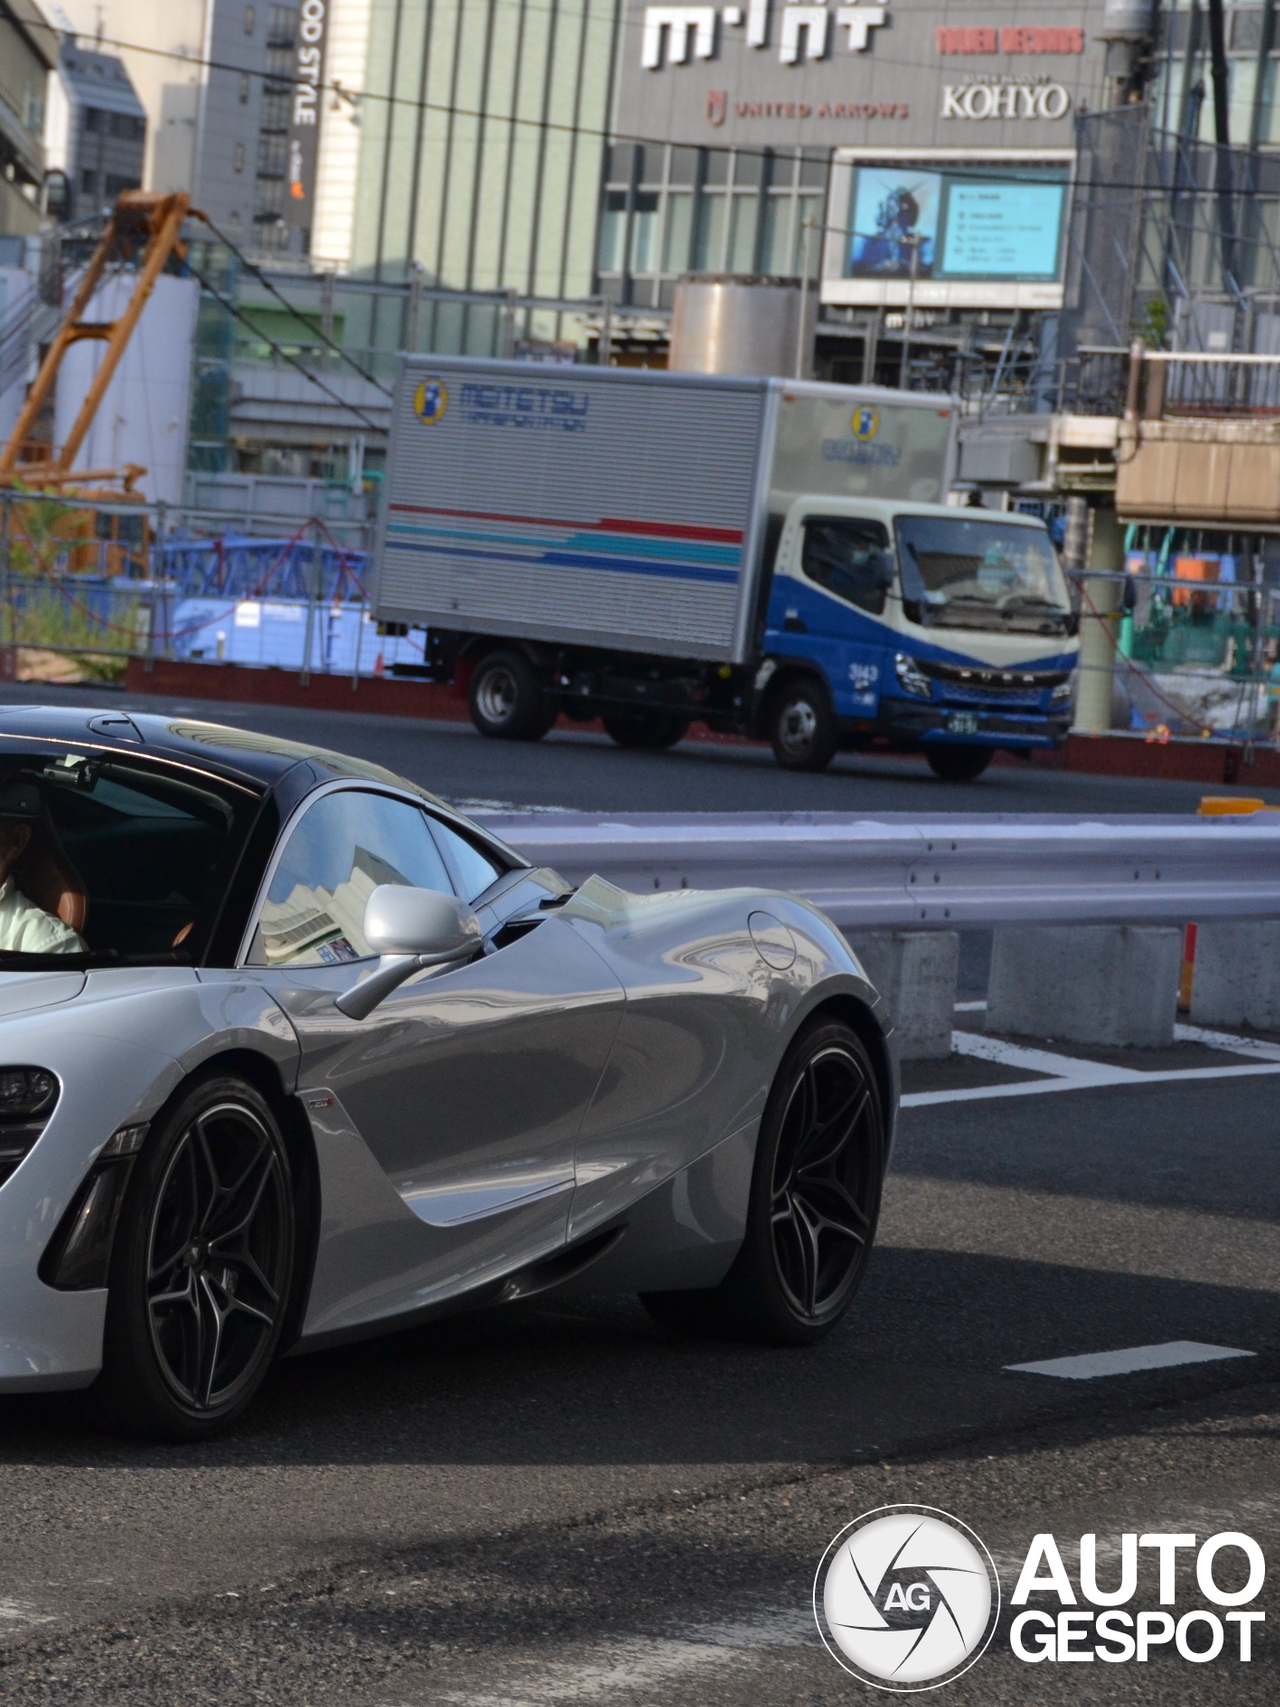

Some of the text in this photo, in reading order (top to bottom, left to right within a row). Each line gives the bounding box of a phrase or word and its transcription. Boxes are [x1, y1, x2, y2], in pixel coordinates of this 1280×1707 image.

[293, 47, 321, 125] STYLE
[941, 83, 1069, 120] KOHYO
[733, 101, 909, 120] UNITED ARROWS
